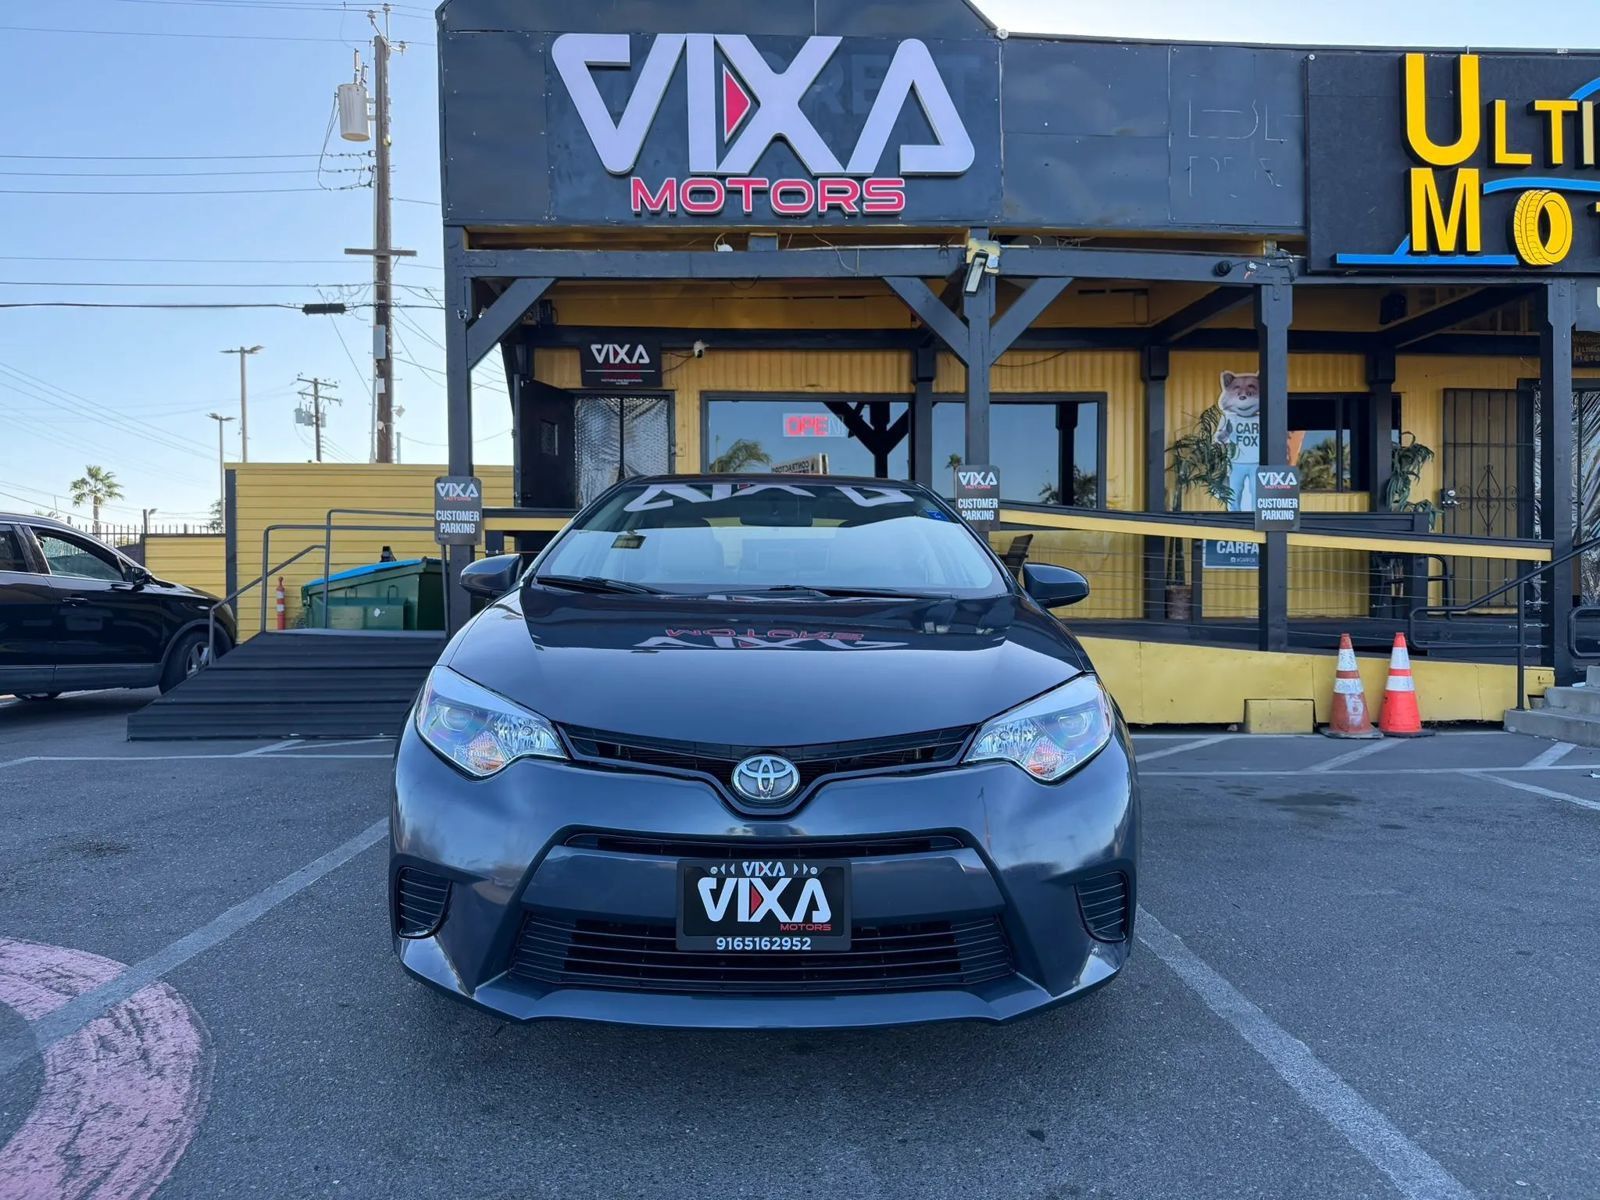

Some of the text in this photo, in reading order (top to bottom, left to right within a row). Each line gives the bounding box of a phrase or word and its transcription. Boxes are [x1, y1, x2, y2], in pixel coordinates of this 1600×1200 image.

[551, 33, 977, 176] VIXA
[630, 176, 906, 215] MOTORS
[1410, 167, 1600, 266] MO
[590, 343, 651, 364] VIXA
[1236, 422, 1259, 434] CAR
[1237, 435, 1258, 447] FOX
[958, 471, 998, 486] VIXA
[1257, 471, 1298, 486] VIXA
[436, 483, 479, 497] VIXA
[957, 498, 998, 509] CUSTOMER
[1257, 497, 1298, 509] CUSTOMER
[436, 510, 480, 521] CUSTOMER
[961, 510, 995, 520] PARKING
[1261, 510, 1295, 520] PARKING
[440, 522, 476, 534] PARKING
[742, 861, 786, 877] VIXA
[697, 877, 832, 923] VIXA
[780, 923, 832, 931] MOTORS
[716, 937, 811, 950] 9165162952
